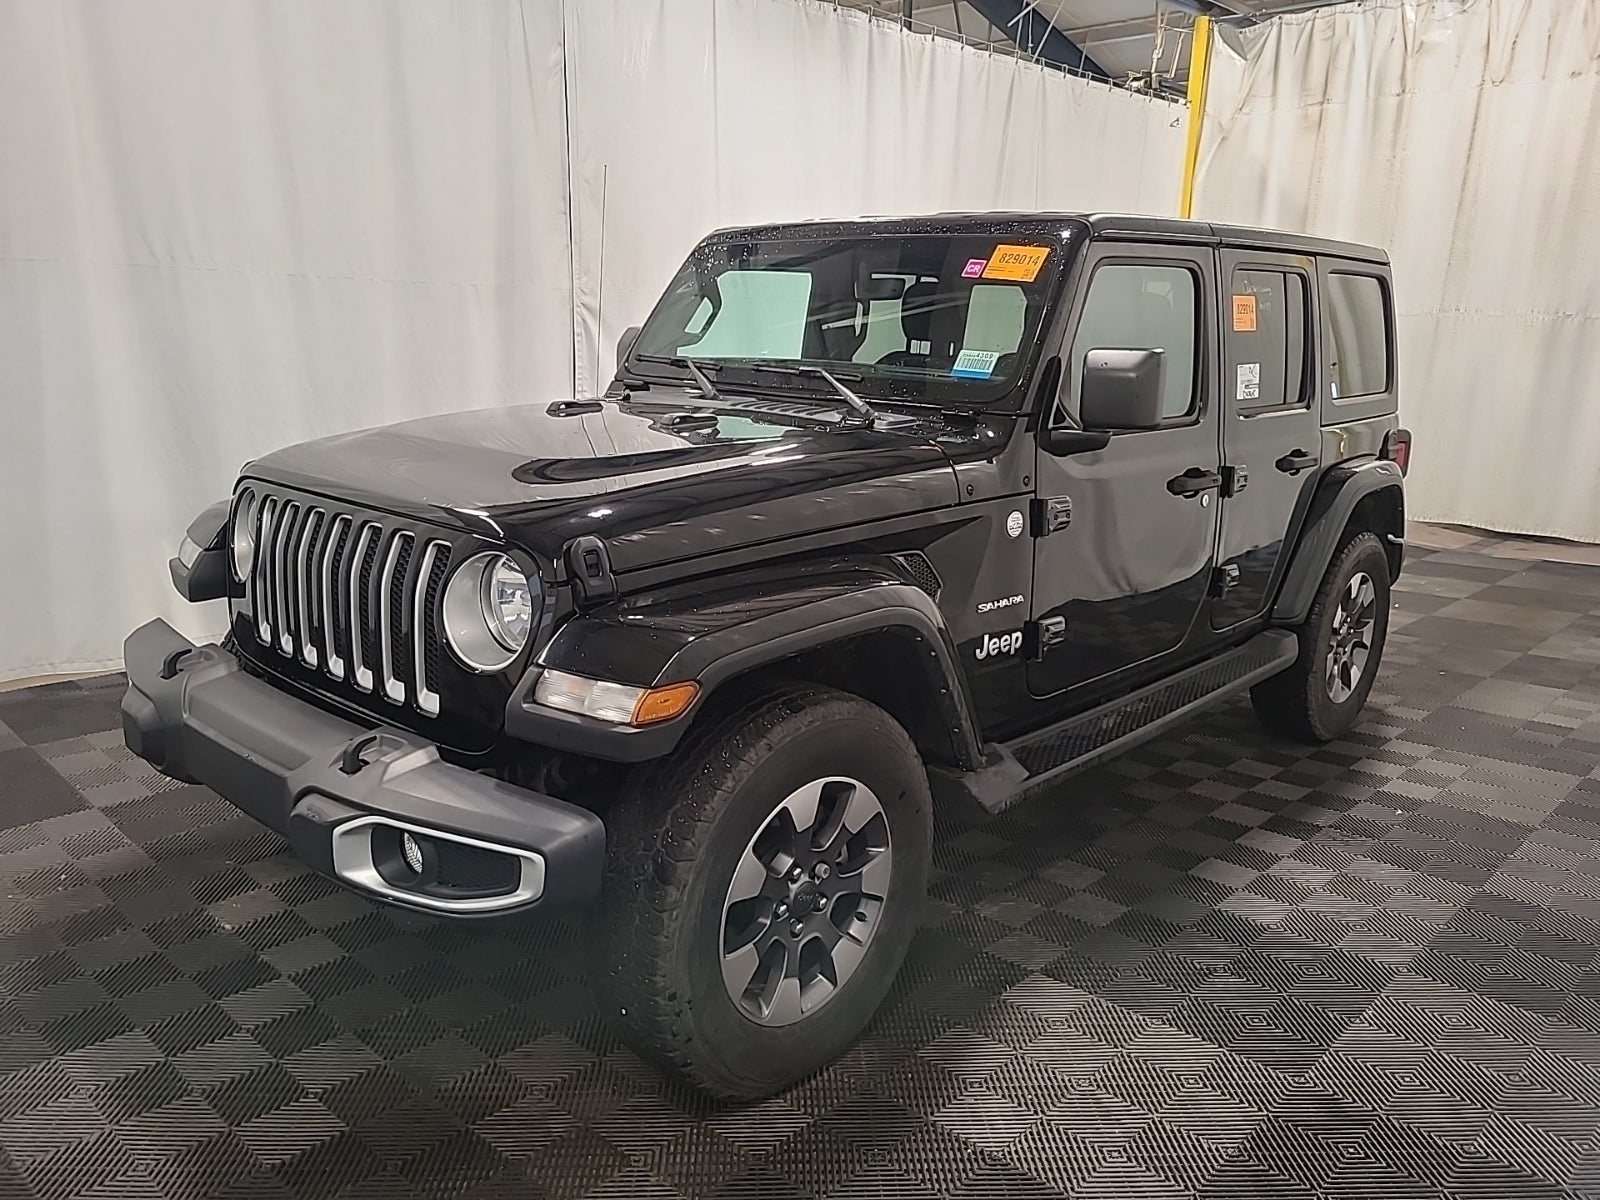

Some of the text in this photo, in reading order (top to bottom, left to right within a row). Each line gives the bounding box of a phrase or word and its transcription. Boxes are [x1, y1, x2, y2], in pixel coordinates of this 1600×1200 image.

[999, 252, 1040, 266] 829014
[967, 264, 981, 273] CR
[977, 594, 1025, 613] SAHARA
[975, 631, 1023, 660] Jeep
